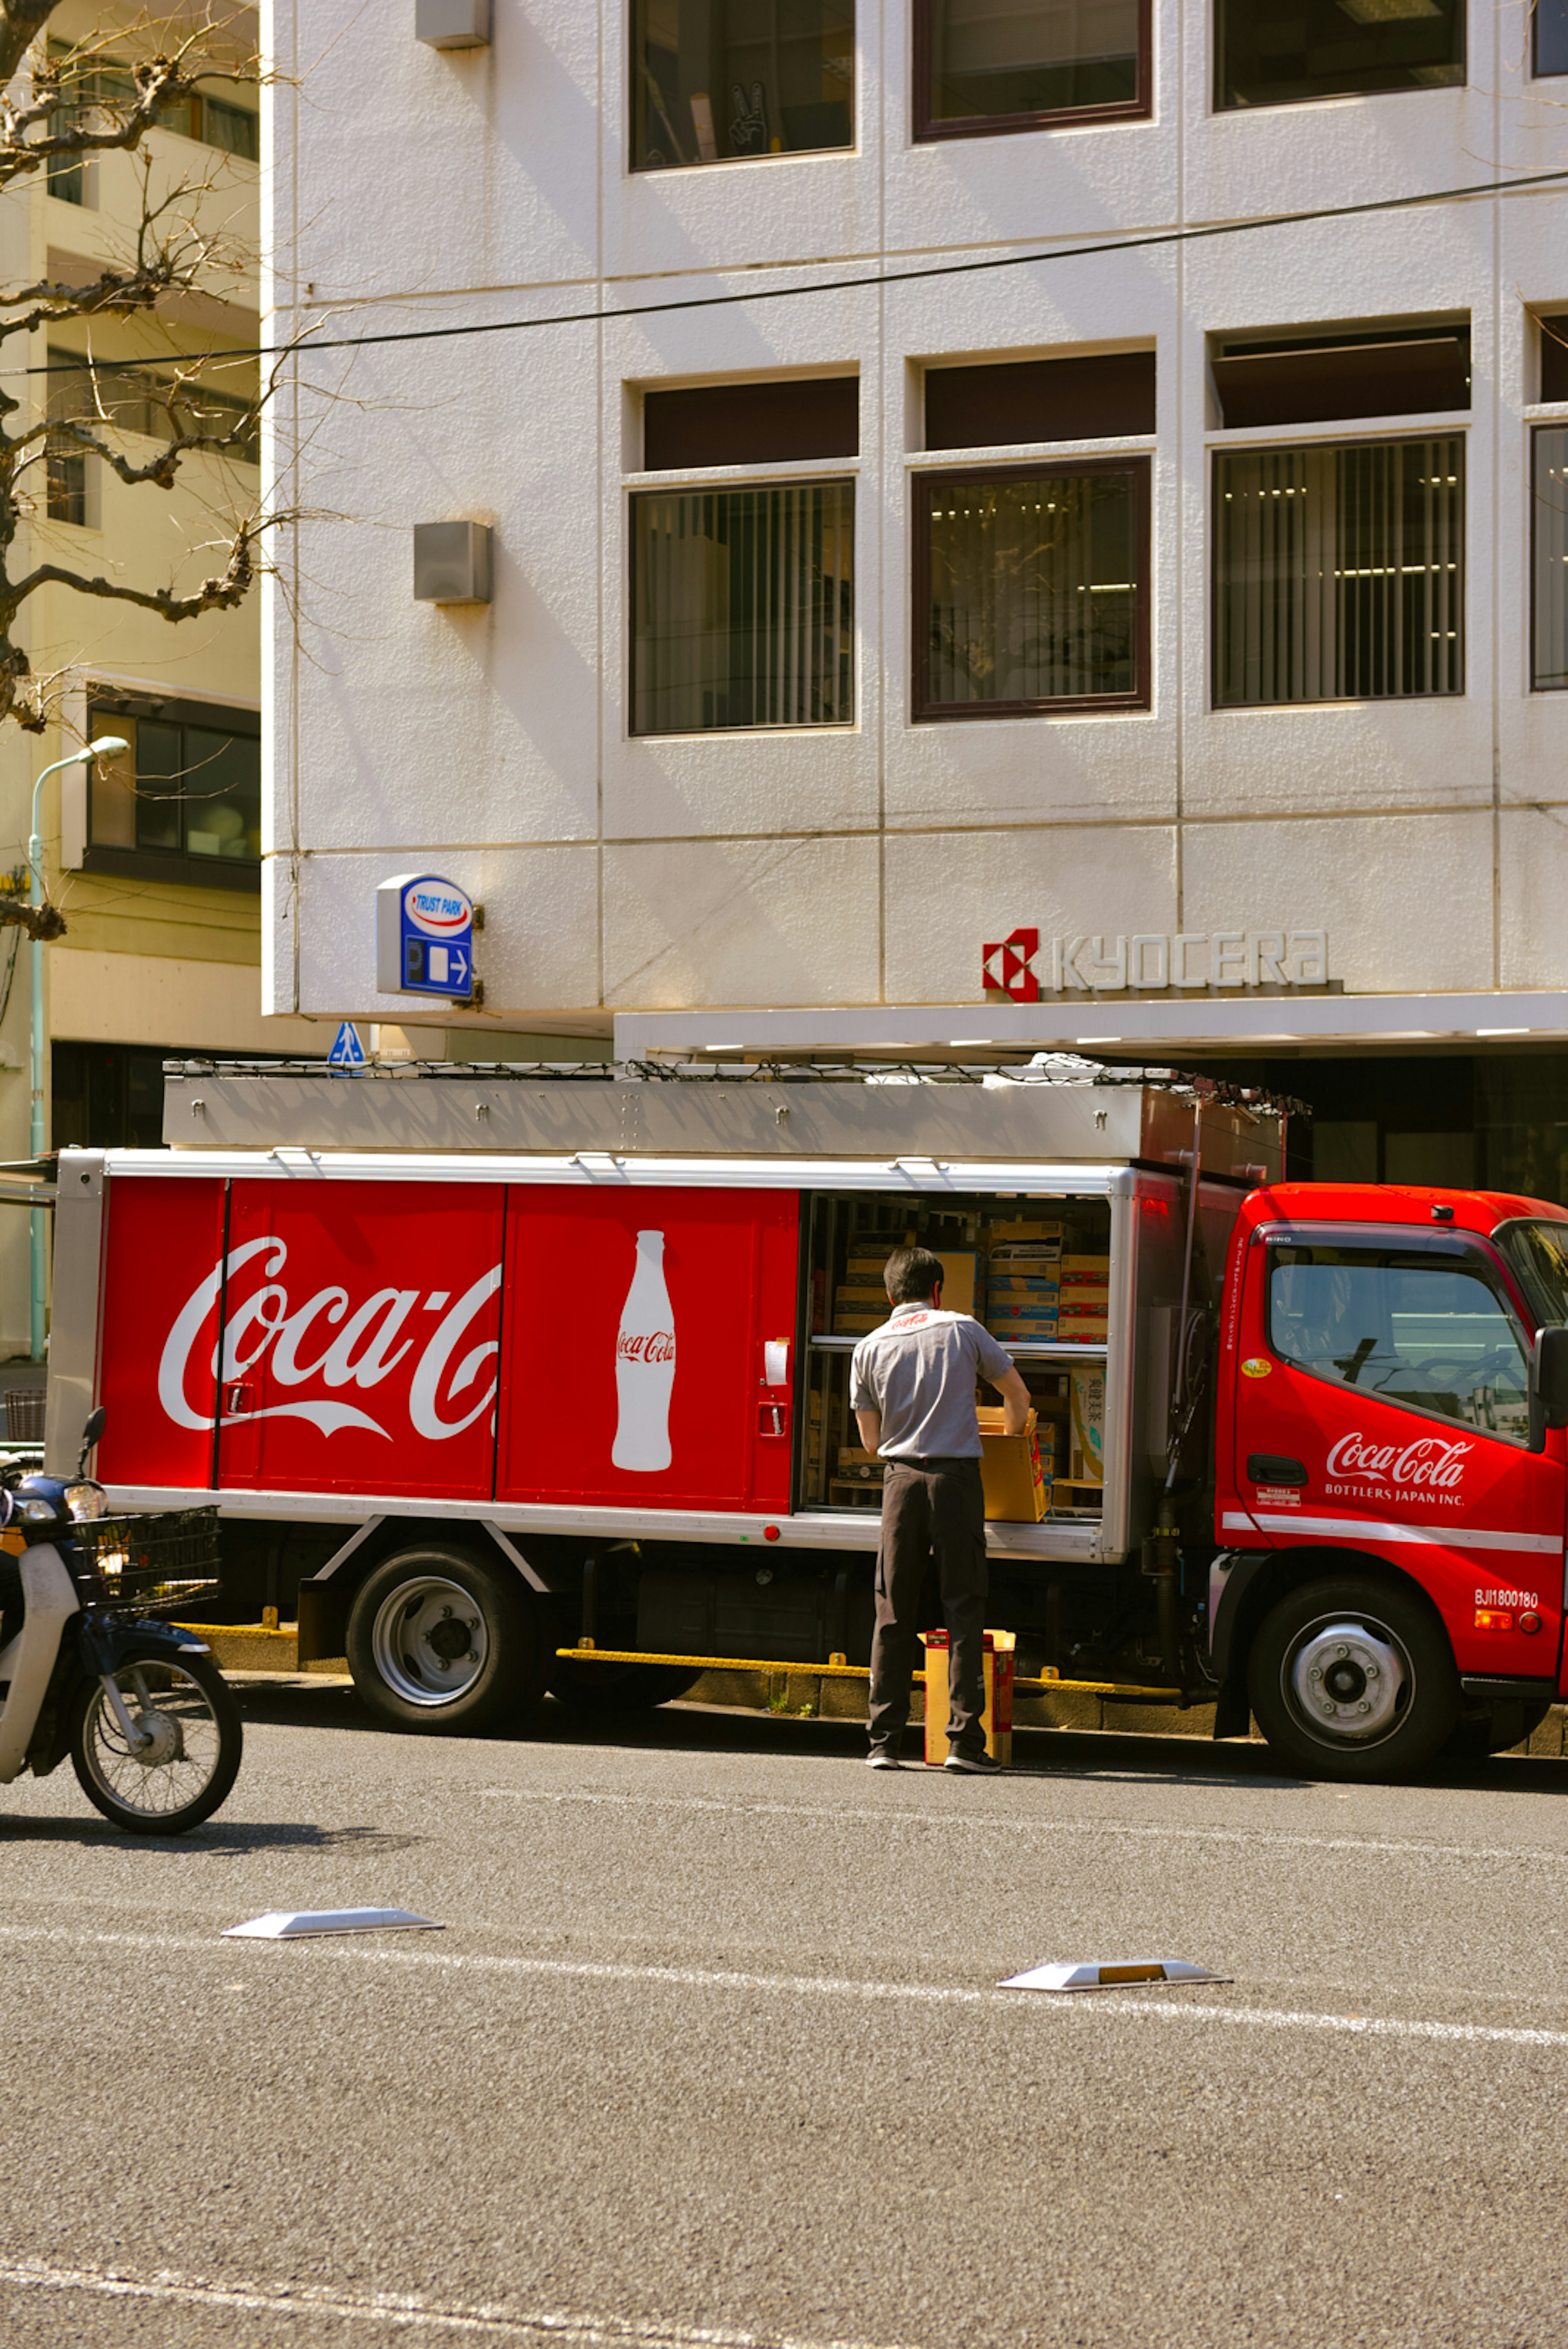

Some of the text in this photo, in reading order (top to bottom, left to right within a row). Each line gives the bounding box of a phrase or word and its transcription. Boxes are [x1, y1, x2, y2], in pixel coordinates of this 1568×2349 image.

[416, 894, 463, 916] TRUST PARK
[1053, 931, 1328, 991] KYOCERA
[158, 1236, 503, 1441] Coca-C
[617, 1331, 674, 1363] Coca-Cola
[1327, 1432, 1476, 1487] Coca-Cola
[1325, 1483, 1465, 1506] BOTTLERS JAPAN INC.
